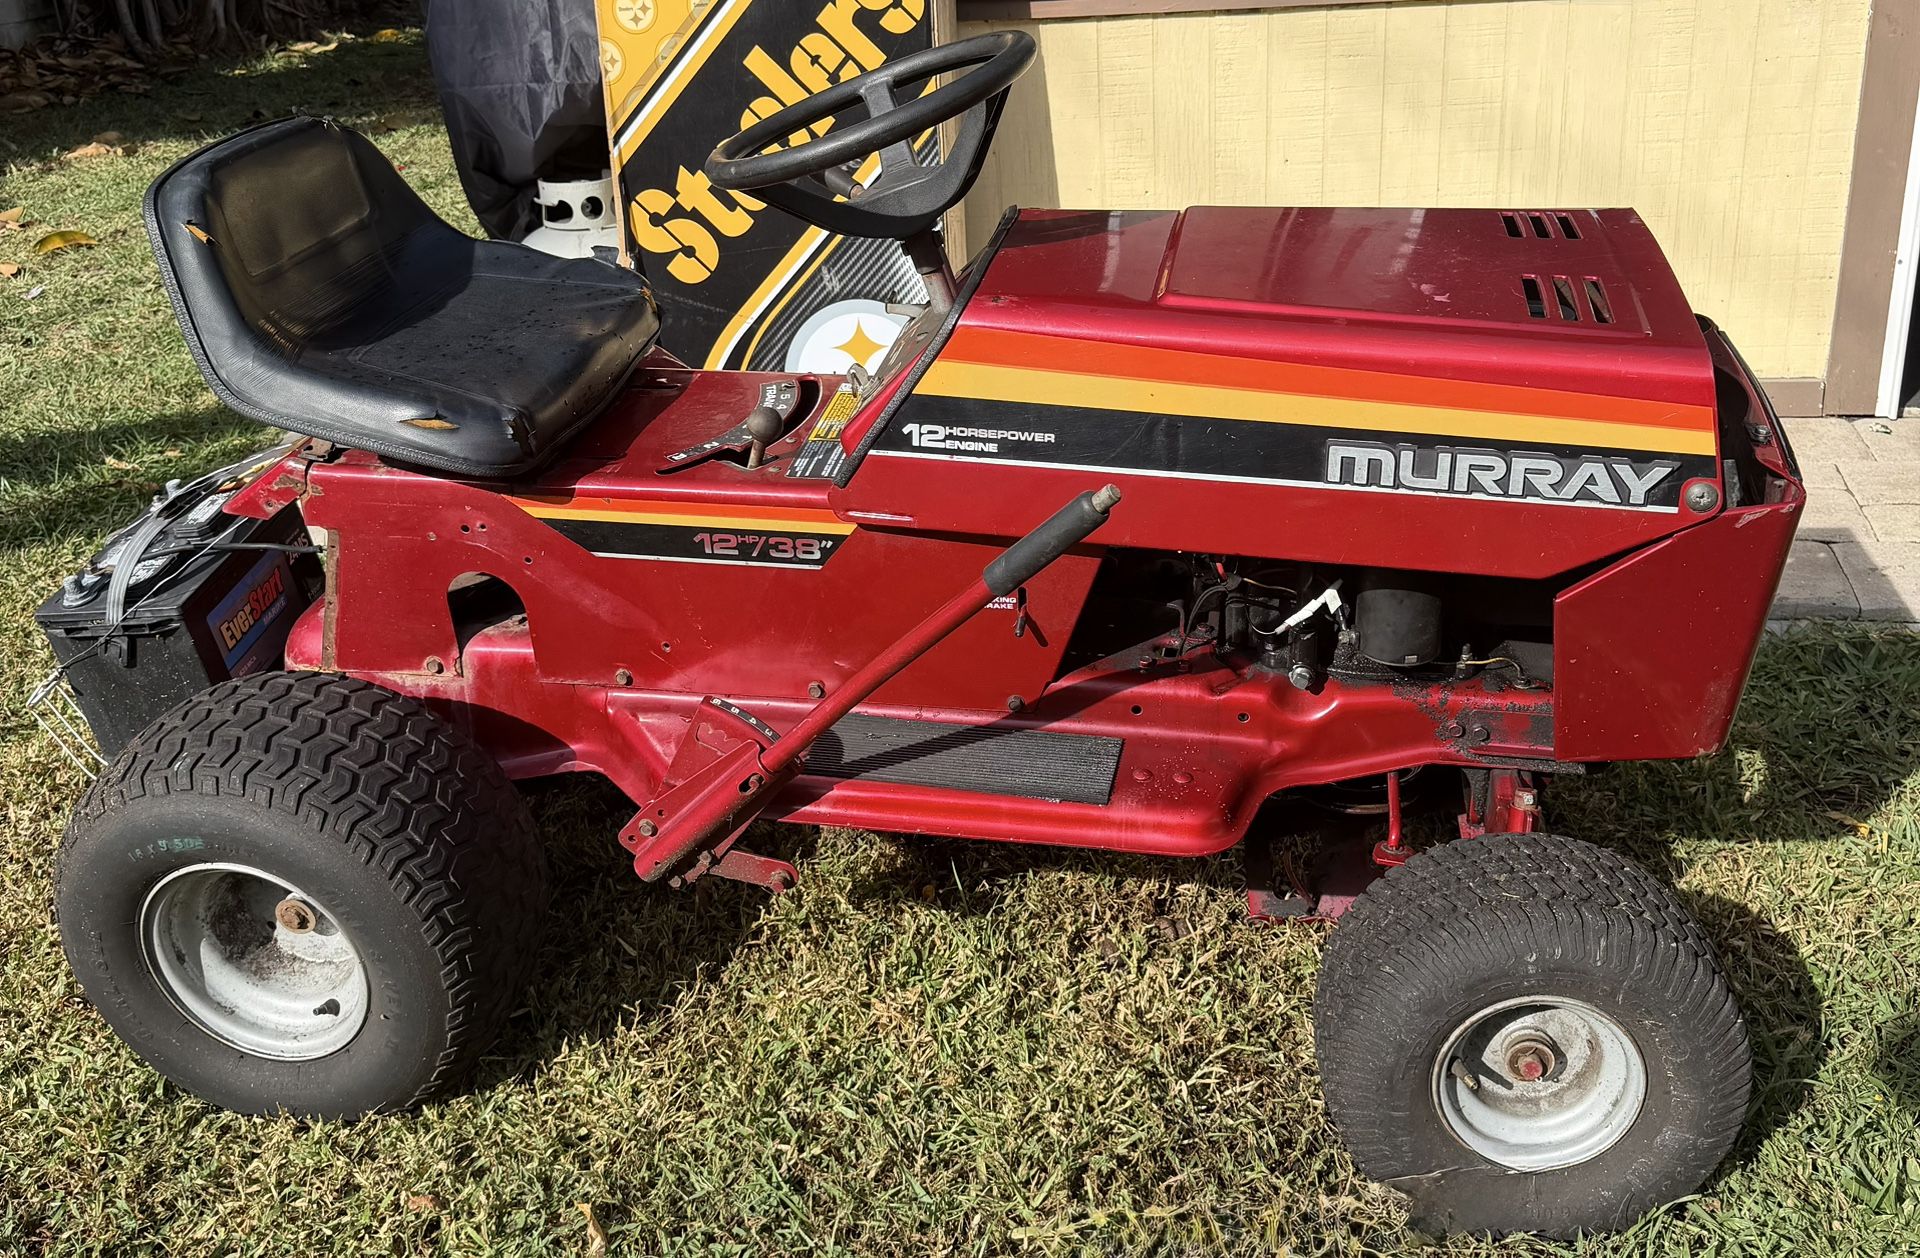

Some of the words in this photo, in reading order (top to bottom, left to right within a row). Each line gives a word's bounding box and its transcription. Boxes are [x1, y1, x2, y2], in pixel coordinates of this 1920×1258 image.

[902, 423, 946, 449] 12
[945, 426, 1056, 443] HORSEPOWER
[945, 440, 999, 453] ENGINE
[1326, 440, 1677, 505] MURRAY
[220, 567, 284, 650] EverStart
